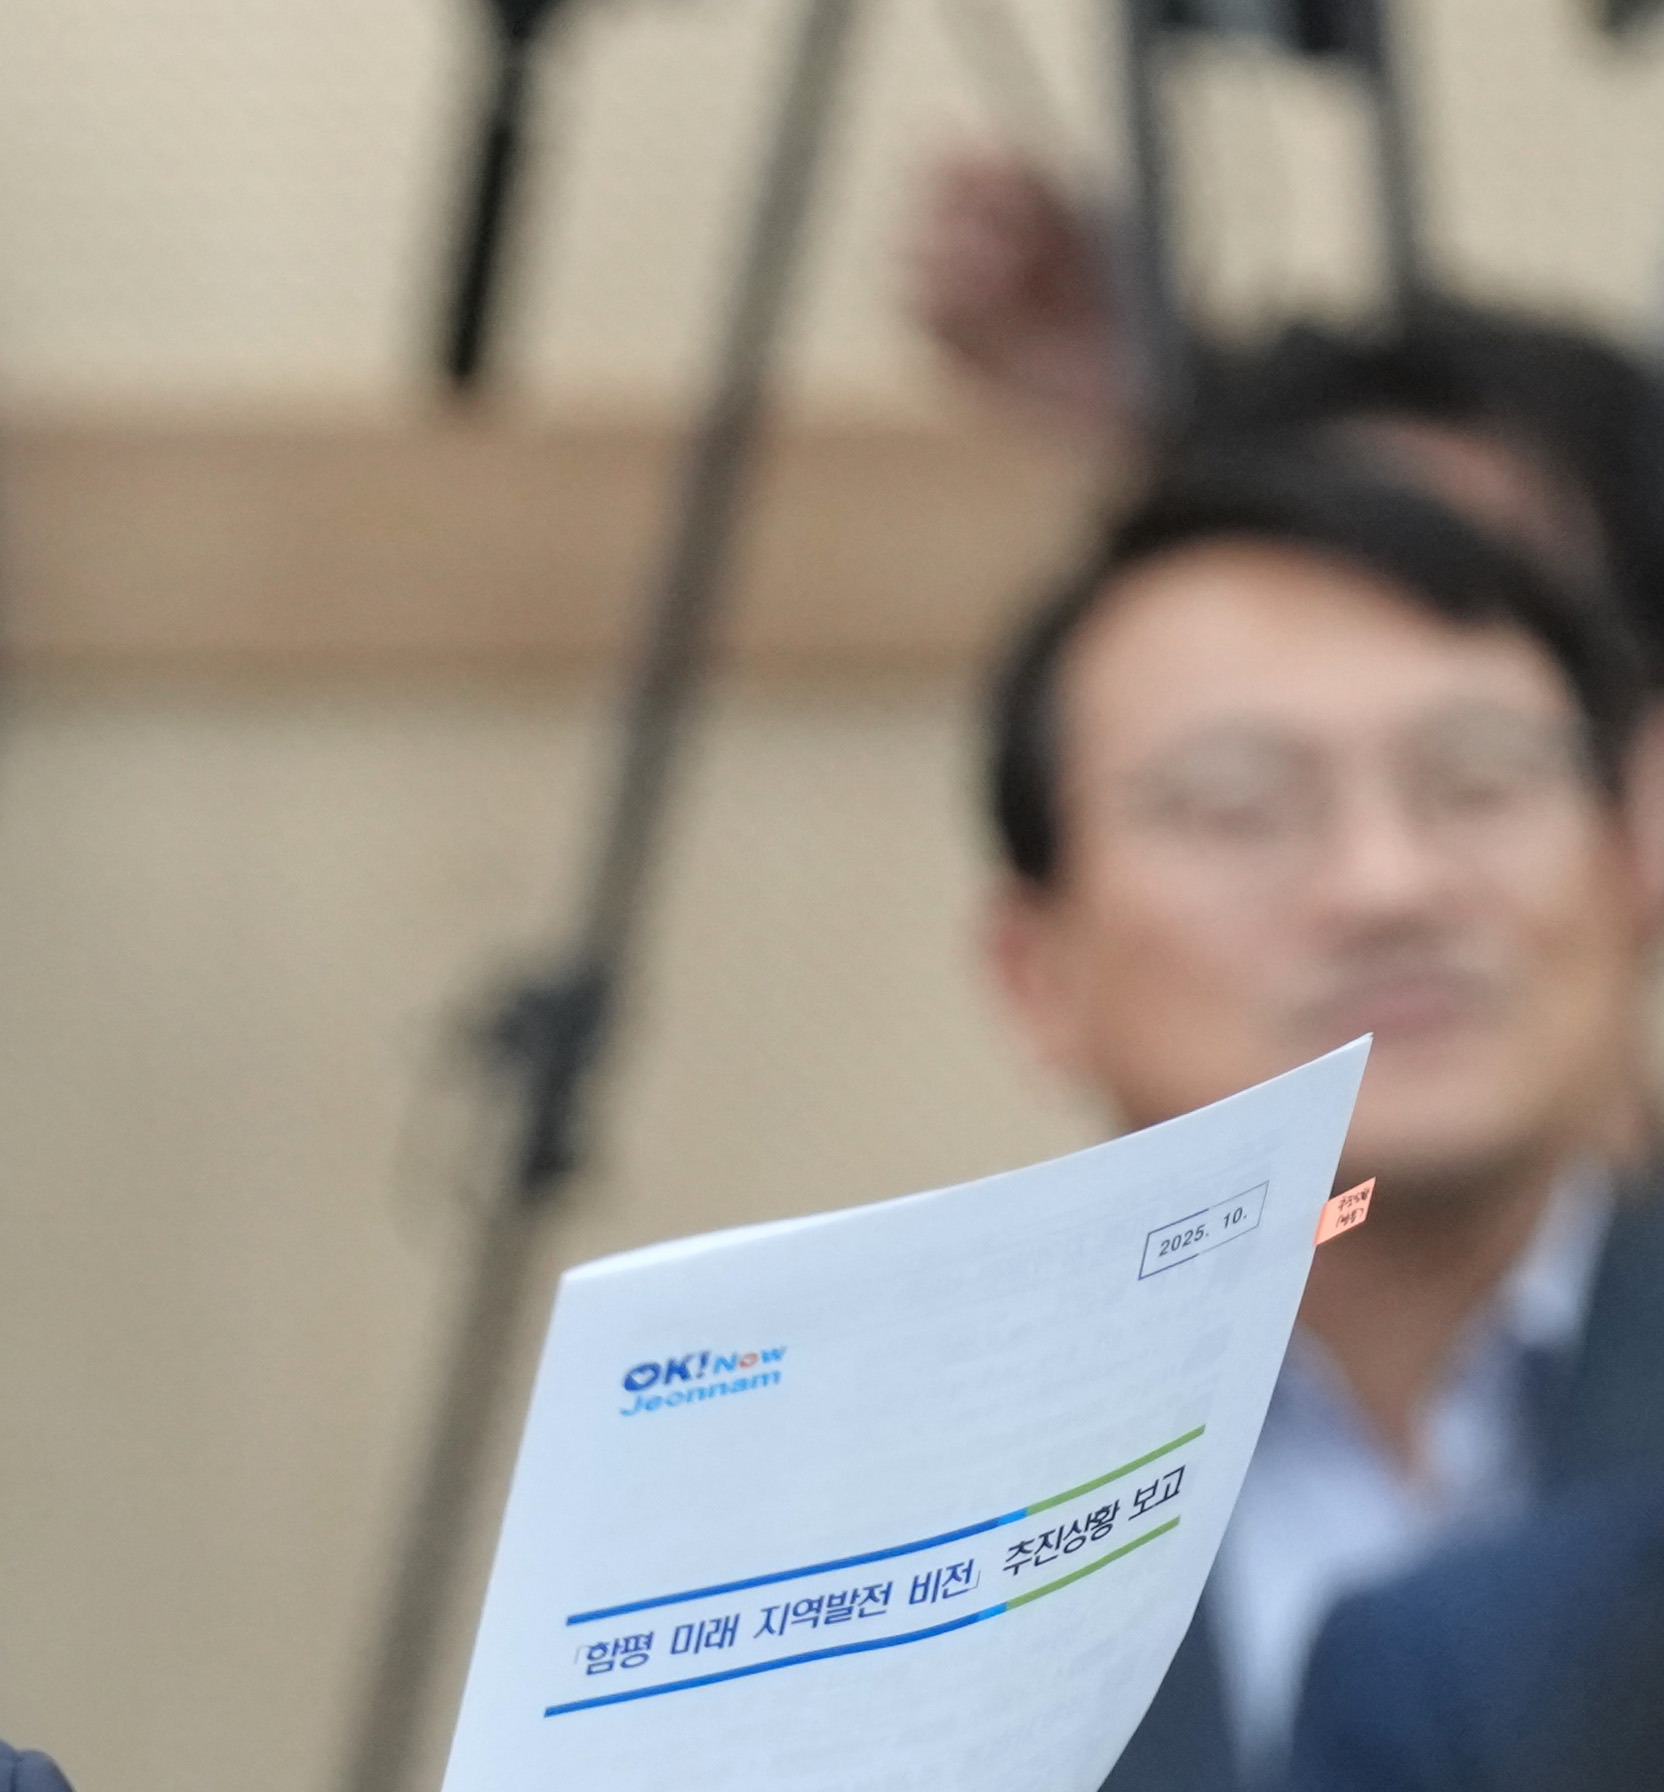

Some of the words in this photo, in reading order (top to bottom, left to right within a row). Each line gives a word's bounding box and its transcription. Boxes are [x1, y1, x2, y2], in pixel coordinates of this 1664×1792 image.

[1158, 1224, 1210, 1257] 2025.
[1223, 1206, 1247, 1229] 10.
[619, 1369, 782, 1416] Jeonnam
[623, 1350, 711, 1393] OK!
[713, 1346, 787, 1375] Now
[669, 1613, 741, 1656] 미래
[753, 1581, 895, 1639] 지역발전
[1002, 1499, 1121, 1577] 추진상황
[1127, 1464, 1187, 1521] 보고
